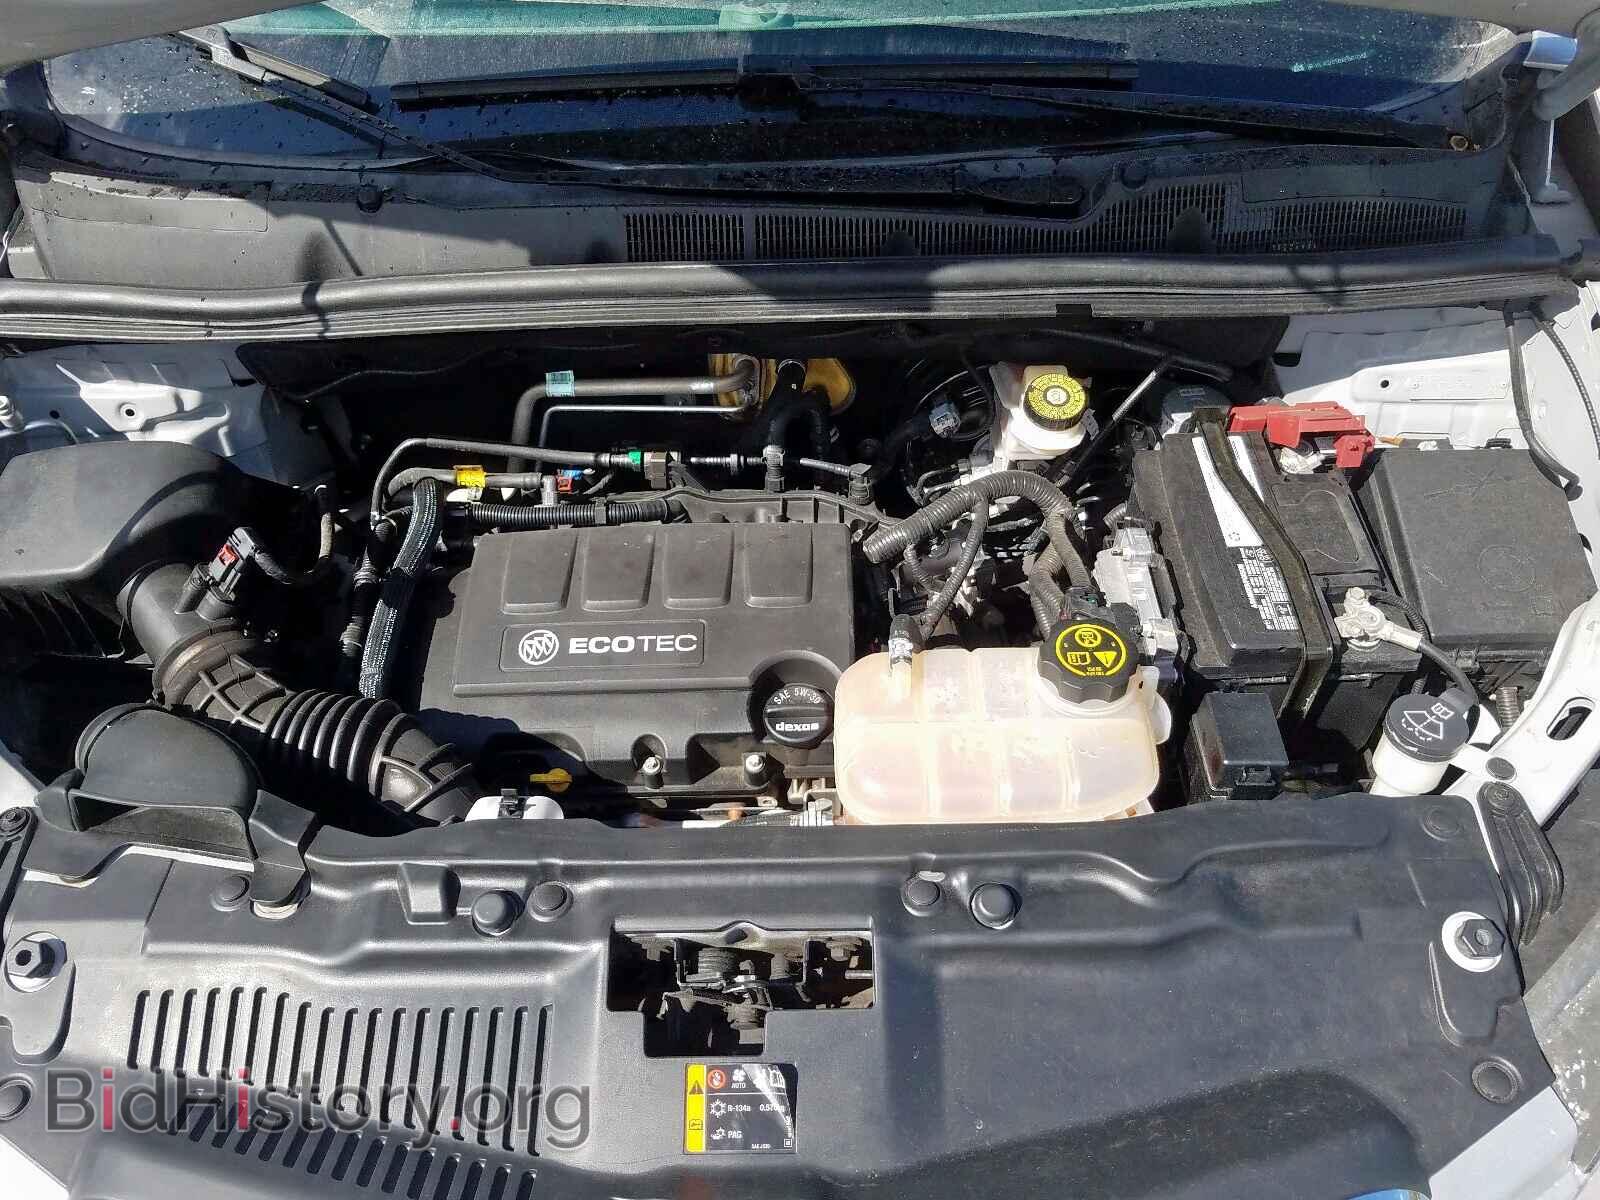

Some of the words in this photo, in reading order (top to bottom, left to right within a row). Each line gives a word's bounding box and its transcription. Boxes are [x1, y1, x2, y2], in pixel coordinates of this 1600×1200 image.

[569, 634, 698, 654] ECOTEC
[773, 689, 791, 704] SAE
[794, 687, 821, 704] 5W-30
[727, 1131, 743, 1139] PAG
